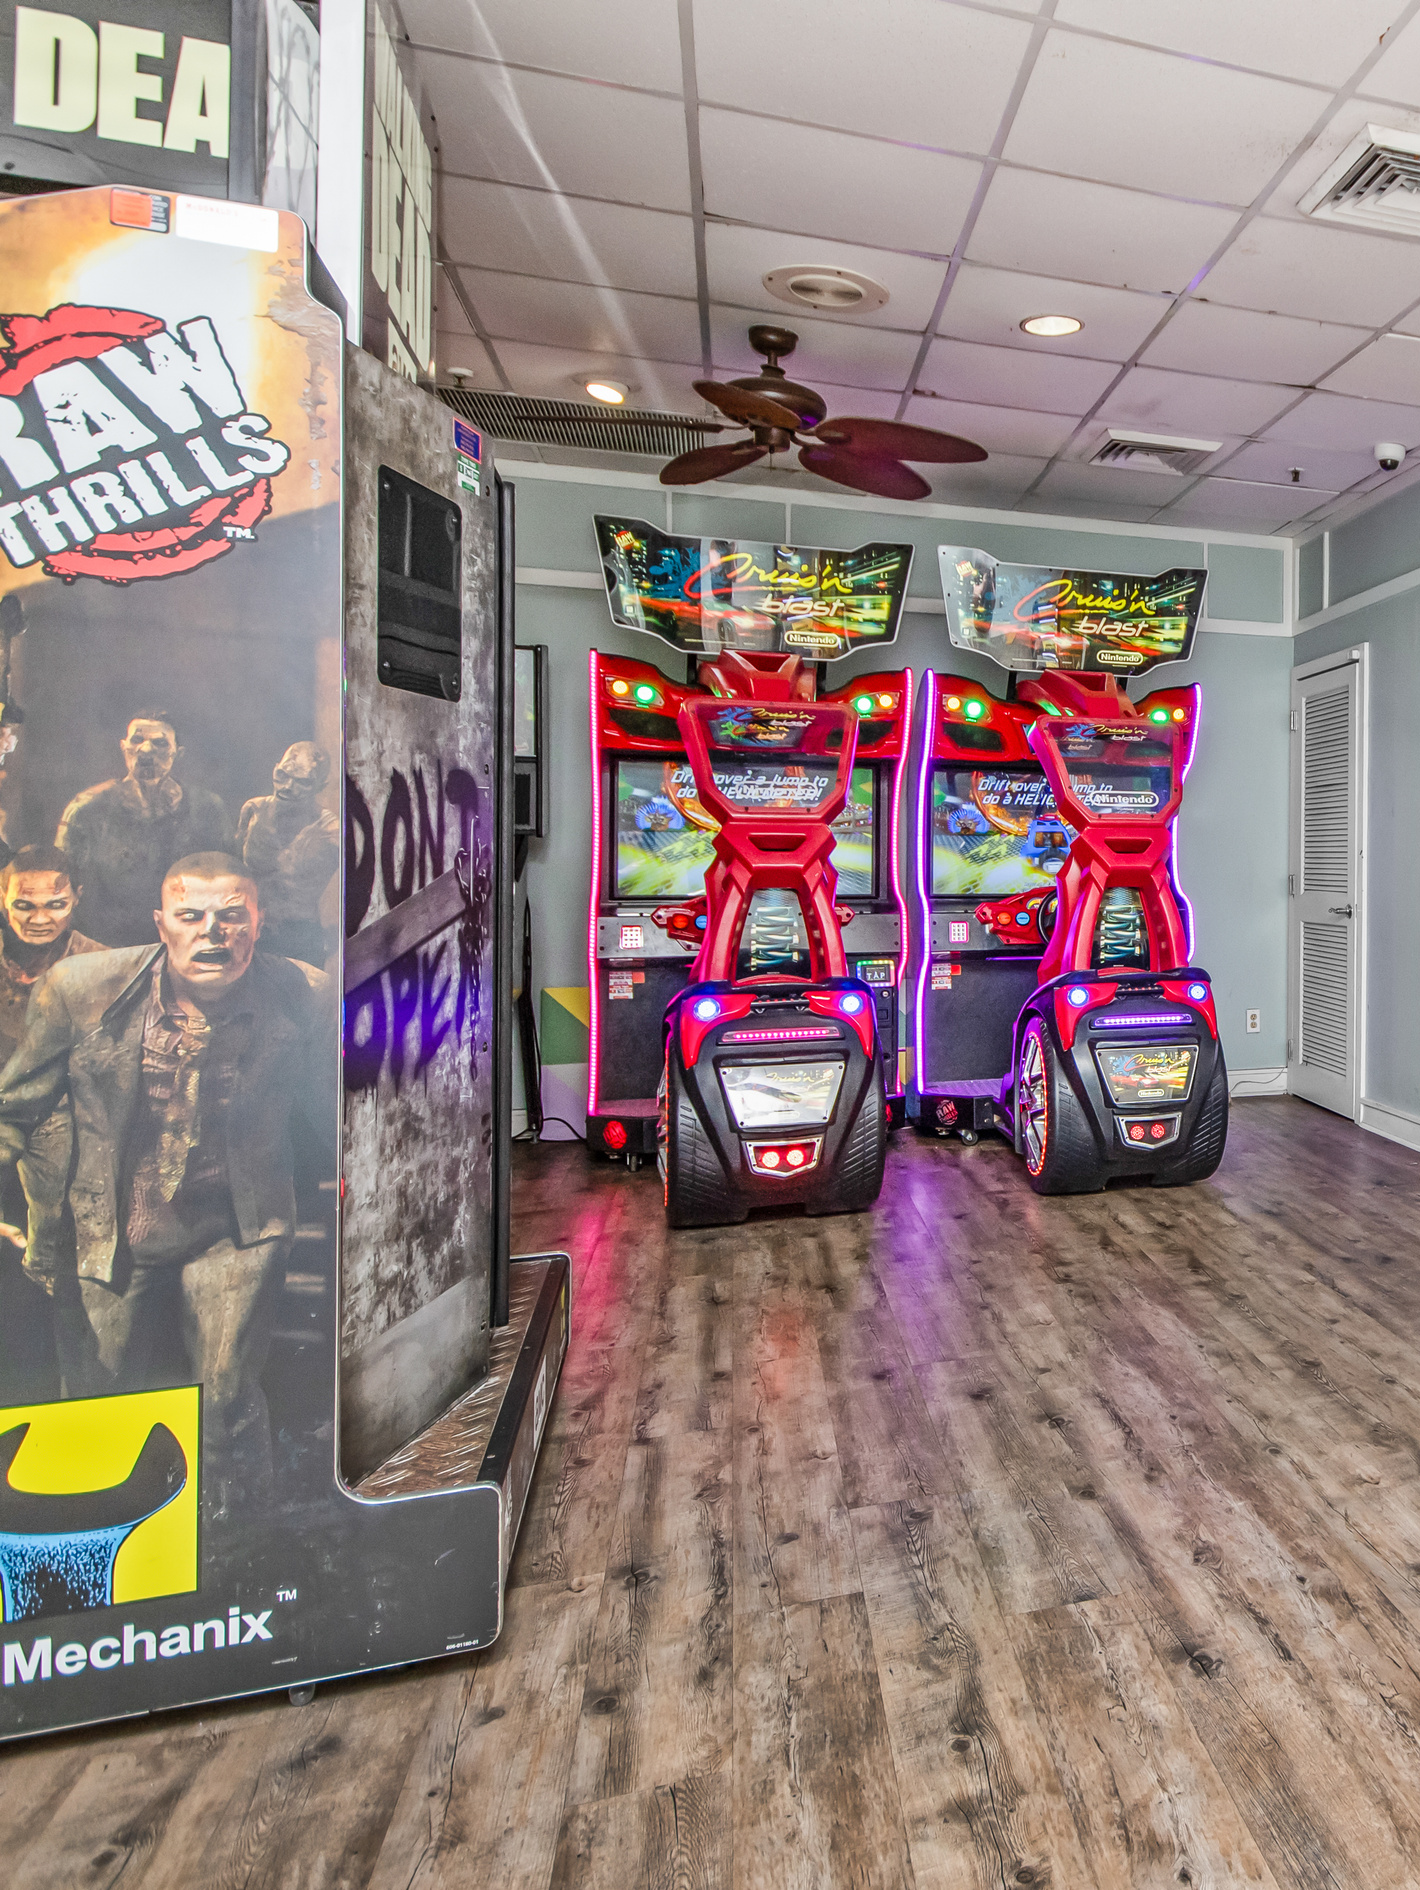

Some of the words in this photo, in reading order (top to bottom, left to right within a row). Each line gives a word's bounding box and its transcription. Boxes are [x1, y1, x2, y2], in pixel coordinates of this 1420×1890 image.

[371, 102, 431, 372] DEAD
[0, 415, 290, 566] THRILLS
[683, 552, 853, 599] Cruis'n
[757, 594, 846, 617] blast
[1013, 578, 1156, 622] Cruis'n
[1077, 616, 1150, 637] blast
[789, 633, 837, 645] Nintendo
[1100, 653, 1140, 663] Nintendo
[676, 786, 697, 798] do
[978, 779, 1011, 792] Drift
[1014, 782, 1045, 793] over
[983, 794, 999, 805] do
[1096, 793, 1154, 805] Nintendo
[3, 1607, 274, 1686] Mechanix
